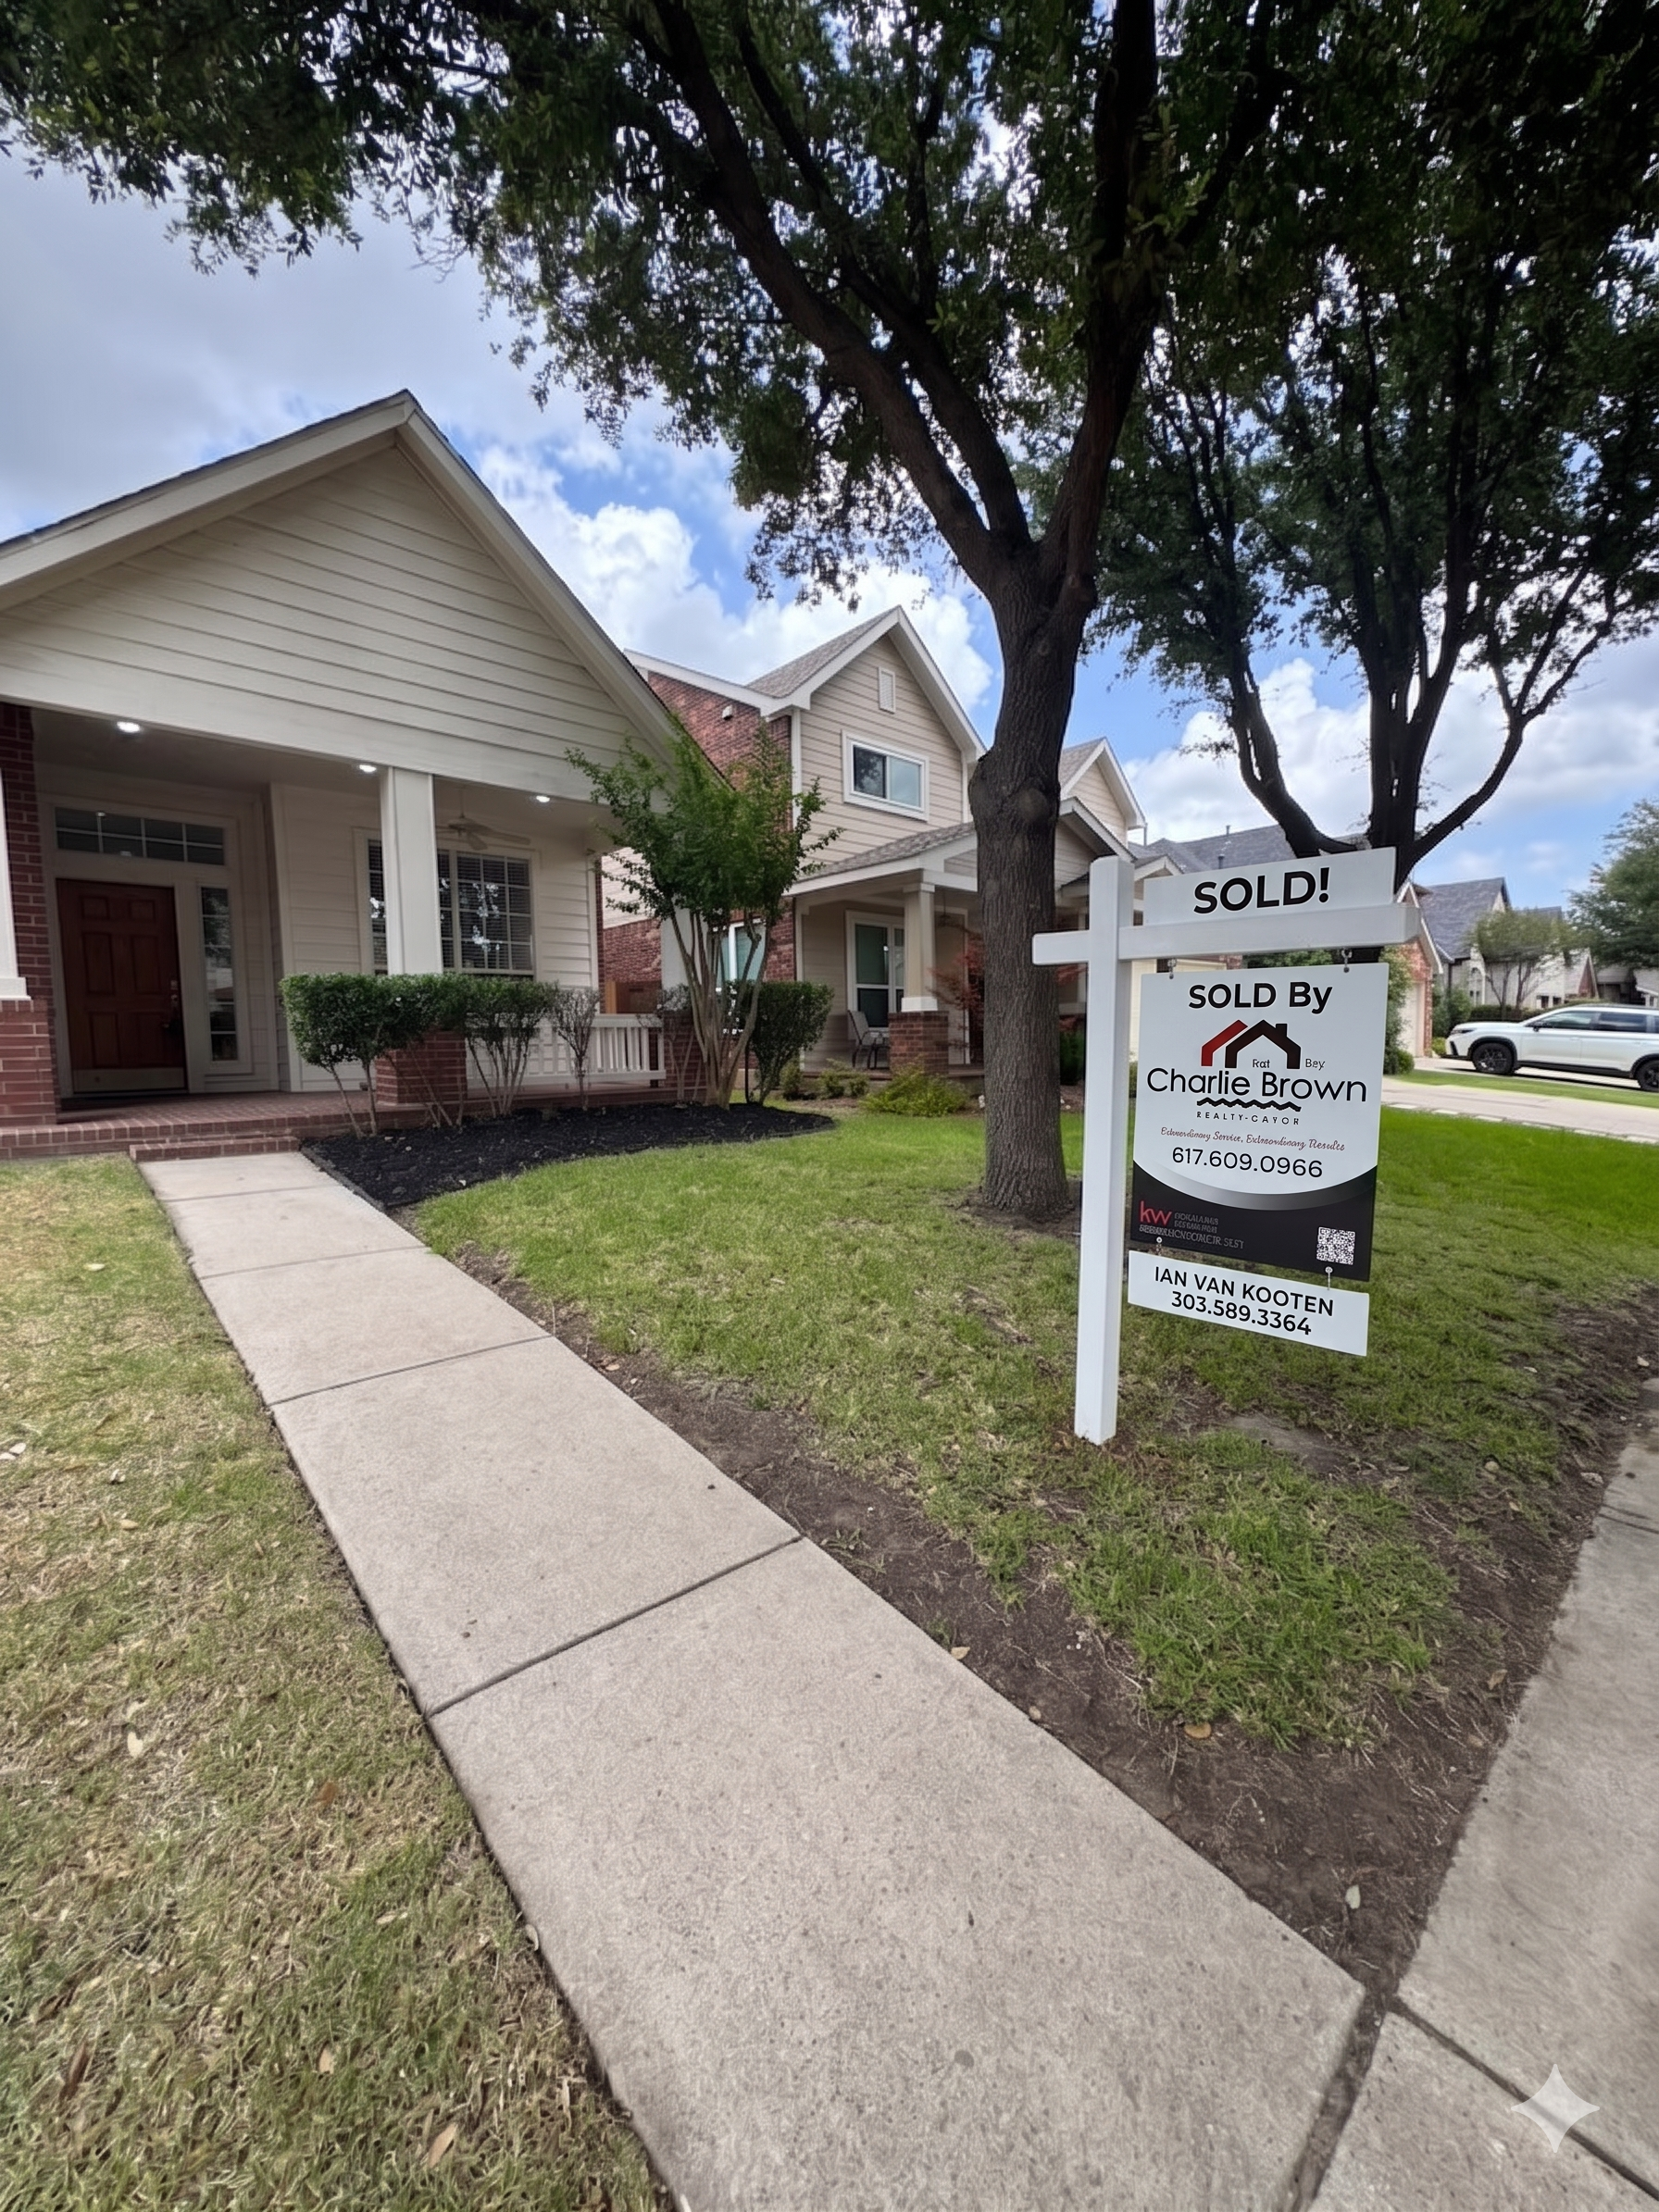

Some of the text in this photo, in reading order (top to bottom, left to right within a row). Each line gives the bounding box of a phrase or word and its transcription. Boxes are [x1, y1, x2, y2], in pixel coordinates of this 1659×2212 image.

[1193, 867, 1330, 914] SOLD!
[1189, 981, 1333, 1014] SOLD By
[1147, 1067, 1367, 1102] Charlie Brown
[1172, 1146, 1324, 1178] 617.609.0966
[1140, 1200, 1172, 1226] kw
[1154, 1266, 1334, 1317] IAN VAN KOOTEN
[1171, 1290, 1312, 1336] 303.589.3364
